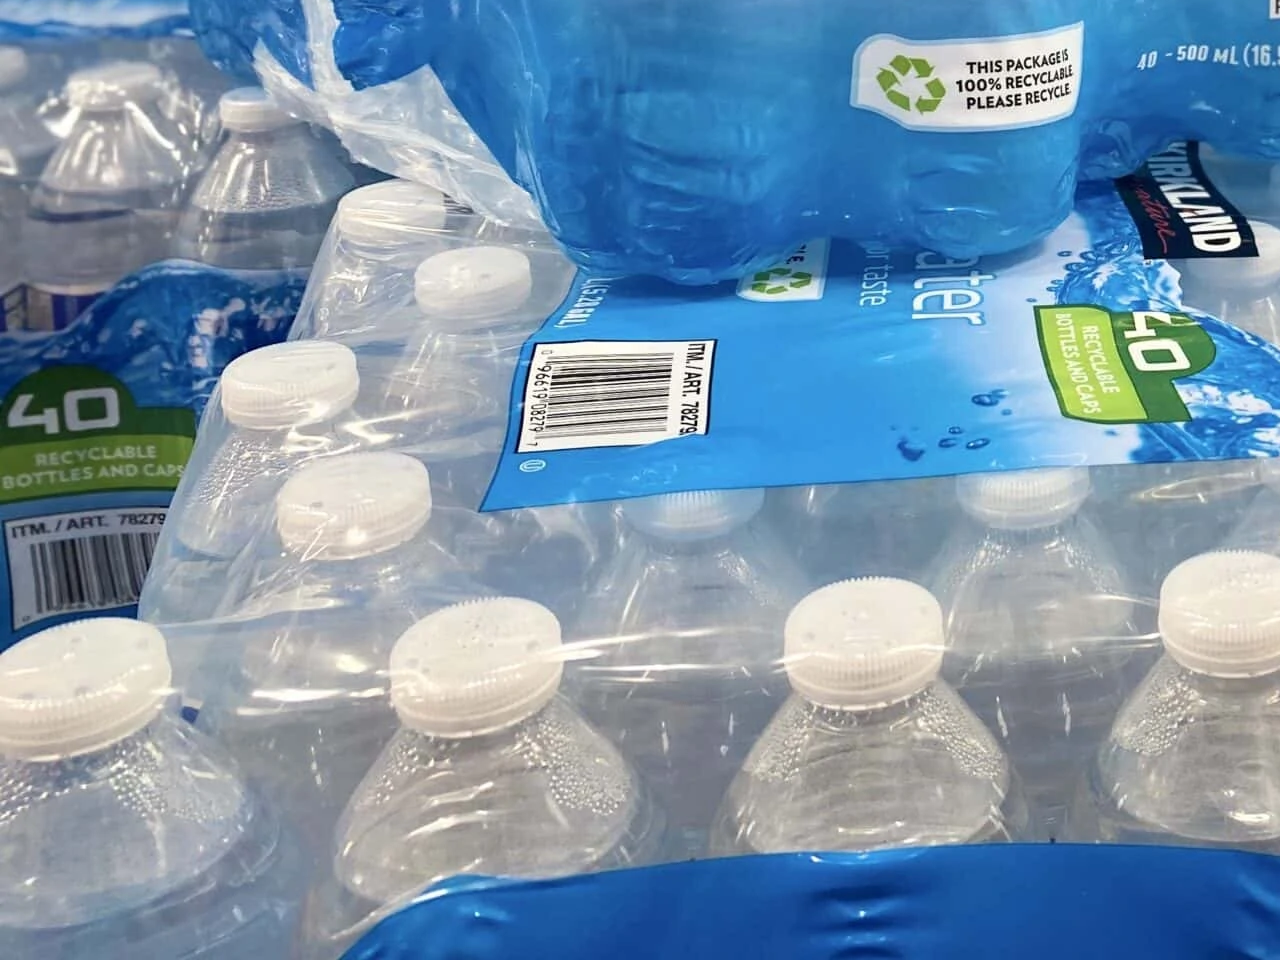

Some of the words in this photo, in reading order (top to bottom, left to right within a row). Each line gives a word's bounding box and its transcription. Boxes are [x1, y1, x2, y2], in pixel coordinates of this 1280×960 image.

[966, 60, 1003, 74] THIS
[1006, 51, 1061, 71] PACKAGE
[1062, 48, 1069, 62] IS
[1137, 51, 1157, 72] 40
[1176, 45, 1209, 62] 500
[956, 78, 1002, 92] 100%
[966, 93, 1022, 109] PLEASE
[860, 266, 894, 307] taste
[911, 250, 995, 325] ater
[1055, 313, 1080, 359] BOTTLES
[1124, 311, 1191, 372] 40
[686, 343, 706, 364] ITM.
[1082, 325, 1120, 394] RECYCLABLE
[533, 365, 552, 400] 96619
[682, 372, 702, 397] ART.
[1065, 359, 1089, 383] AND
[7, 387, 121, 435] 40
[1075, 384, 1102, 414] CAPS
[529, 403, 550, 433] 08279
[679, 401, 699, 435] 78279
[35, 445, 157, 467] RECYCLABLE
[2, 466, 93, 490] BOTTLES
[100, 463, 138, 479] AND
[143, 463, 185, 479] CAPS
[12, 523, 49, 539] ITM.
[66, 514, 109, 532] ART.
